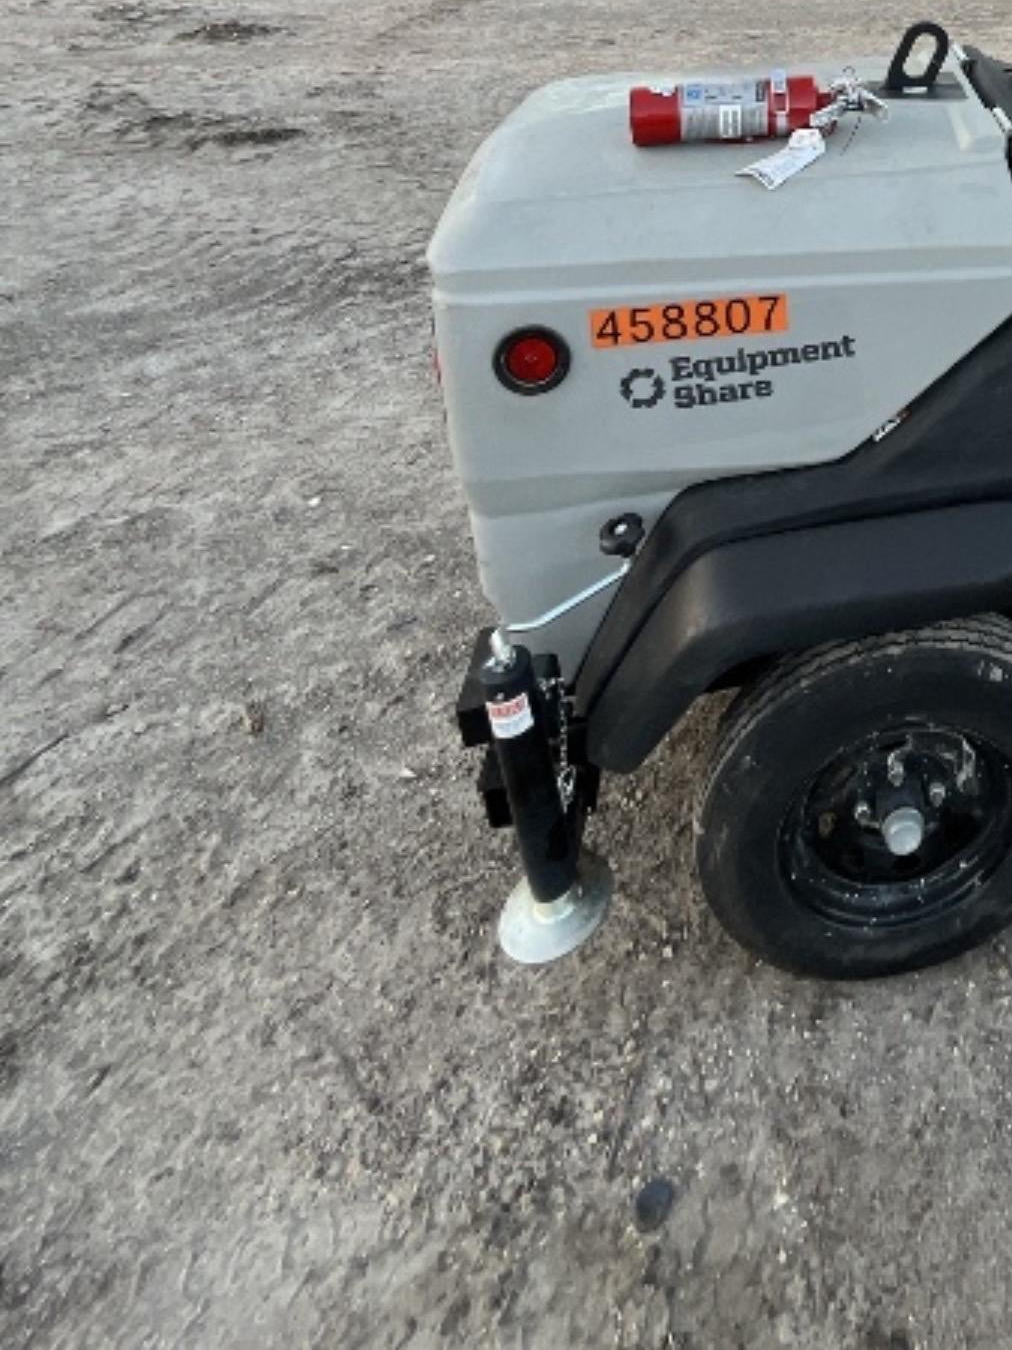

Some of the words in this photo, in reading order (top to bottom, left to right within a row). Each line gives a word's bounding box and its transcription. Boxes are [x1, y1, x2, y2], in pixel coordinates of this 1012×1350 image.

[596, 295, 781, 346] 458807
[669, 335, 856, 381] Equipment
[673, 379, 774, 410] Share
